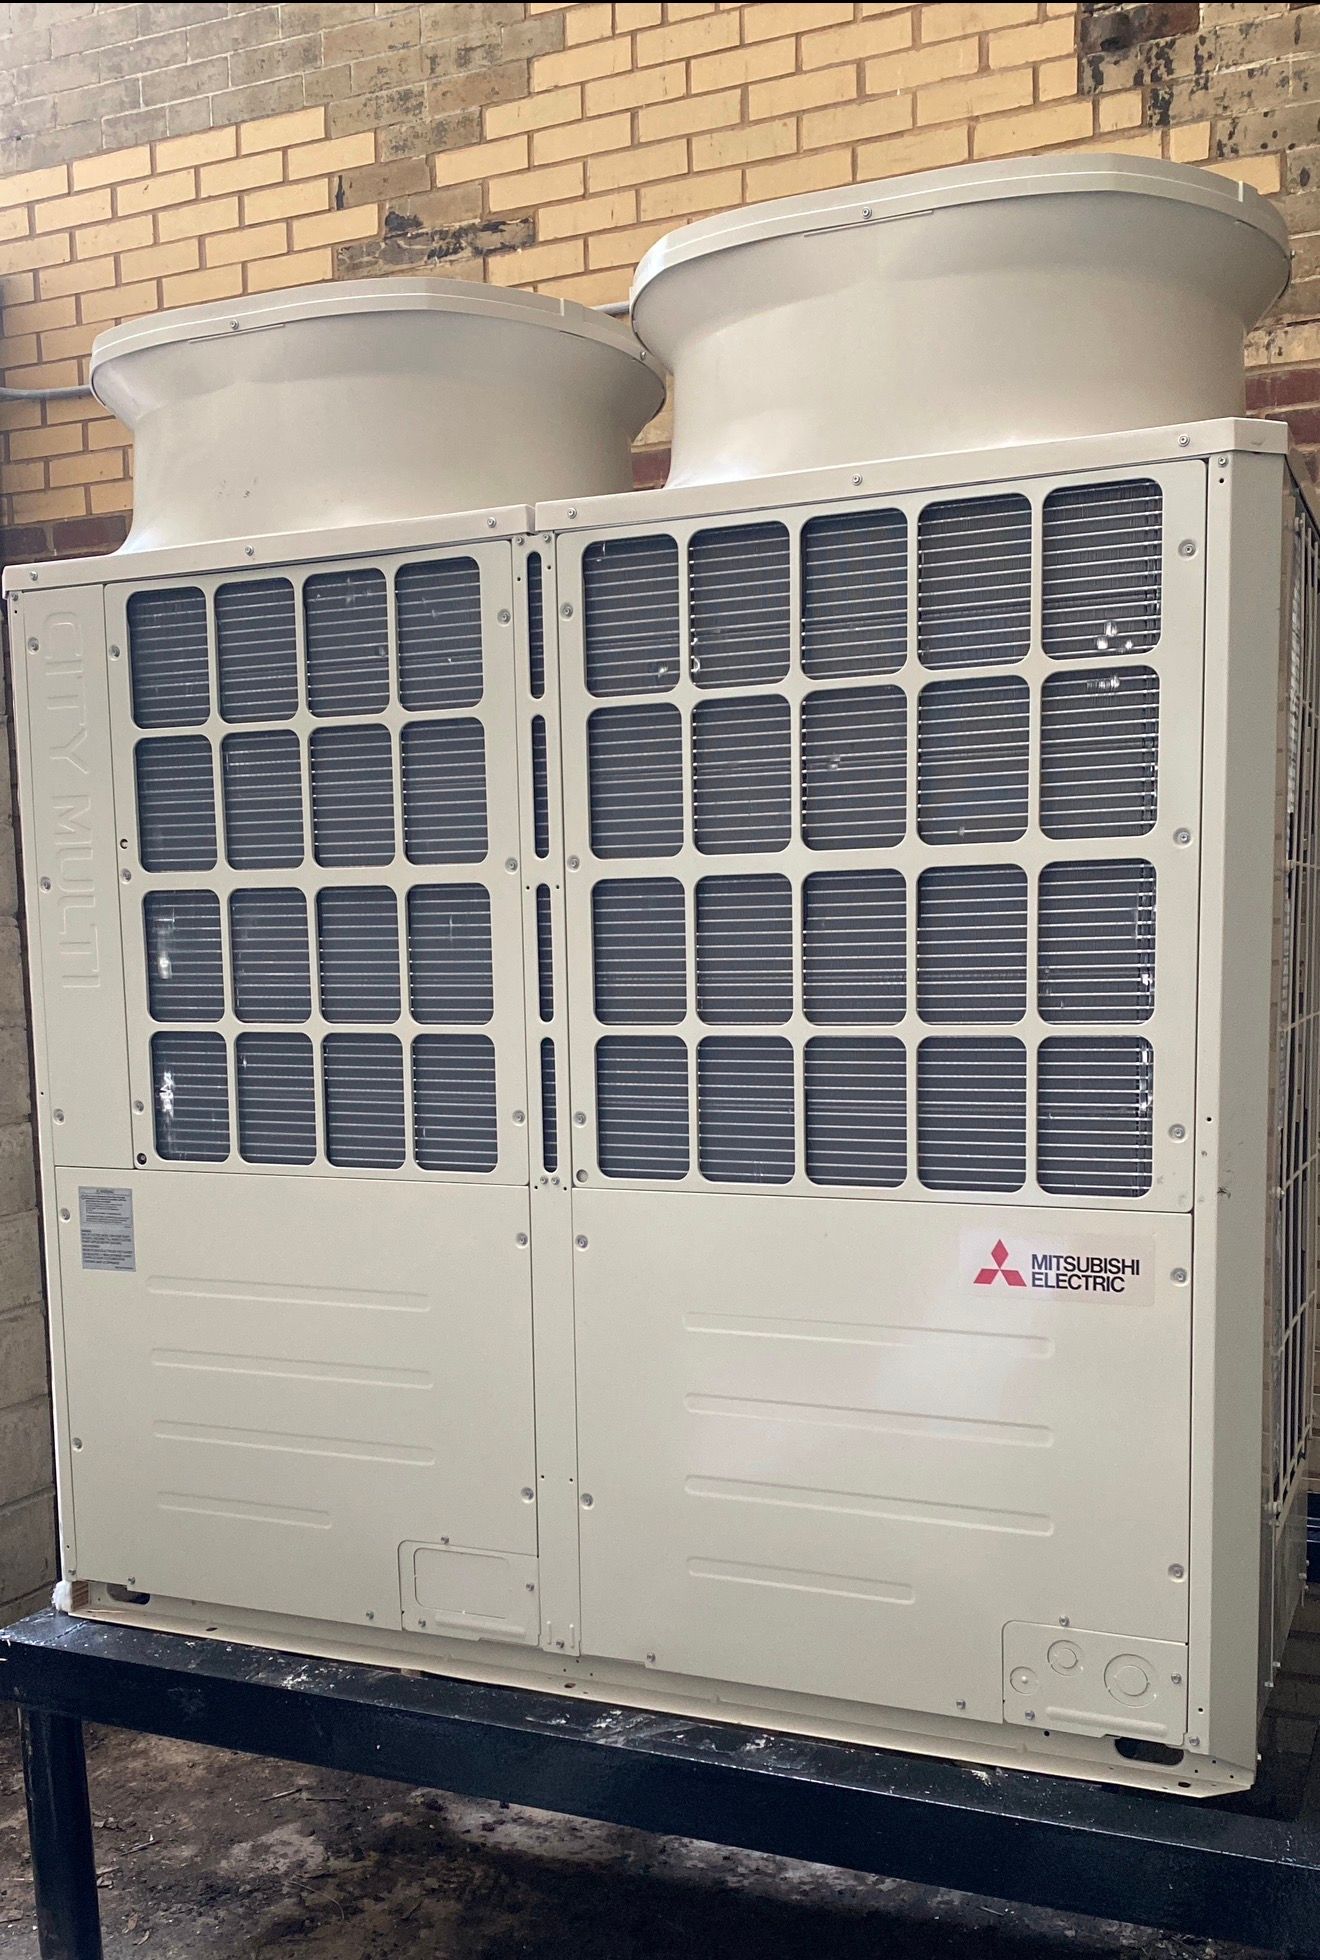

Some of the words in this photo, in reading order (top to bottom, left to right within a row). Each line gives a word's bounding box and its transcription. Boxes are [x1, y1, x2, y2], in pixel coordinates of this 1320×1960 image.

[44, 612, 88, 775] CITY
[51, 795, 101, 990] MULTI
[1031, 1253, 1141, 1276] MITSUBISHI
[1031, 1271, 1126, 1293] ELECTRIC
